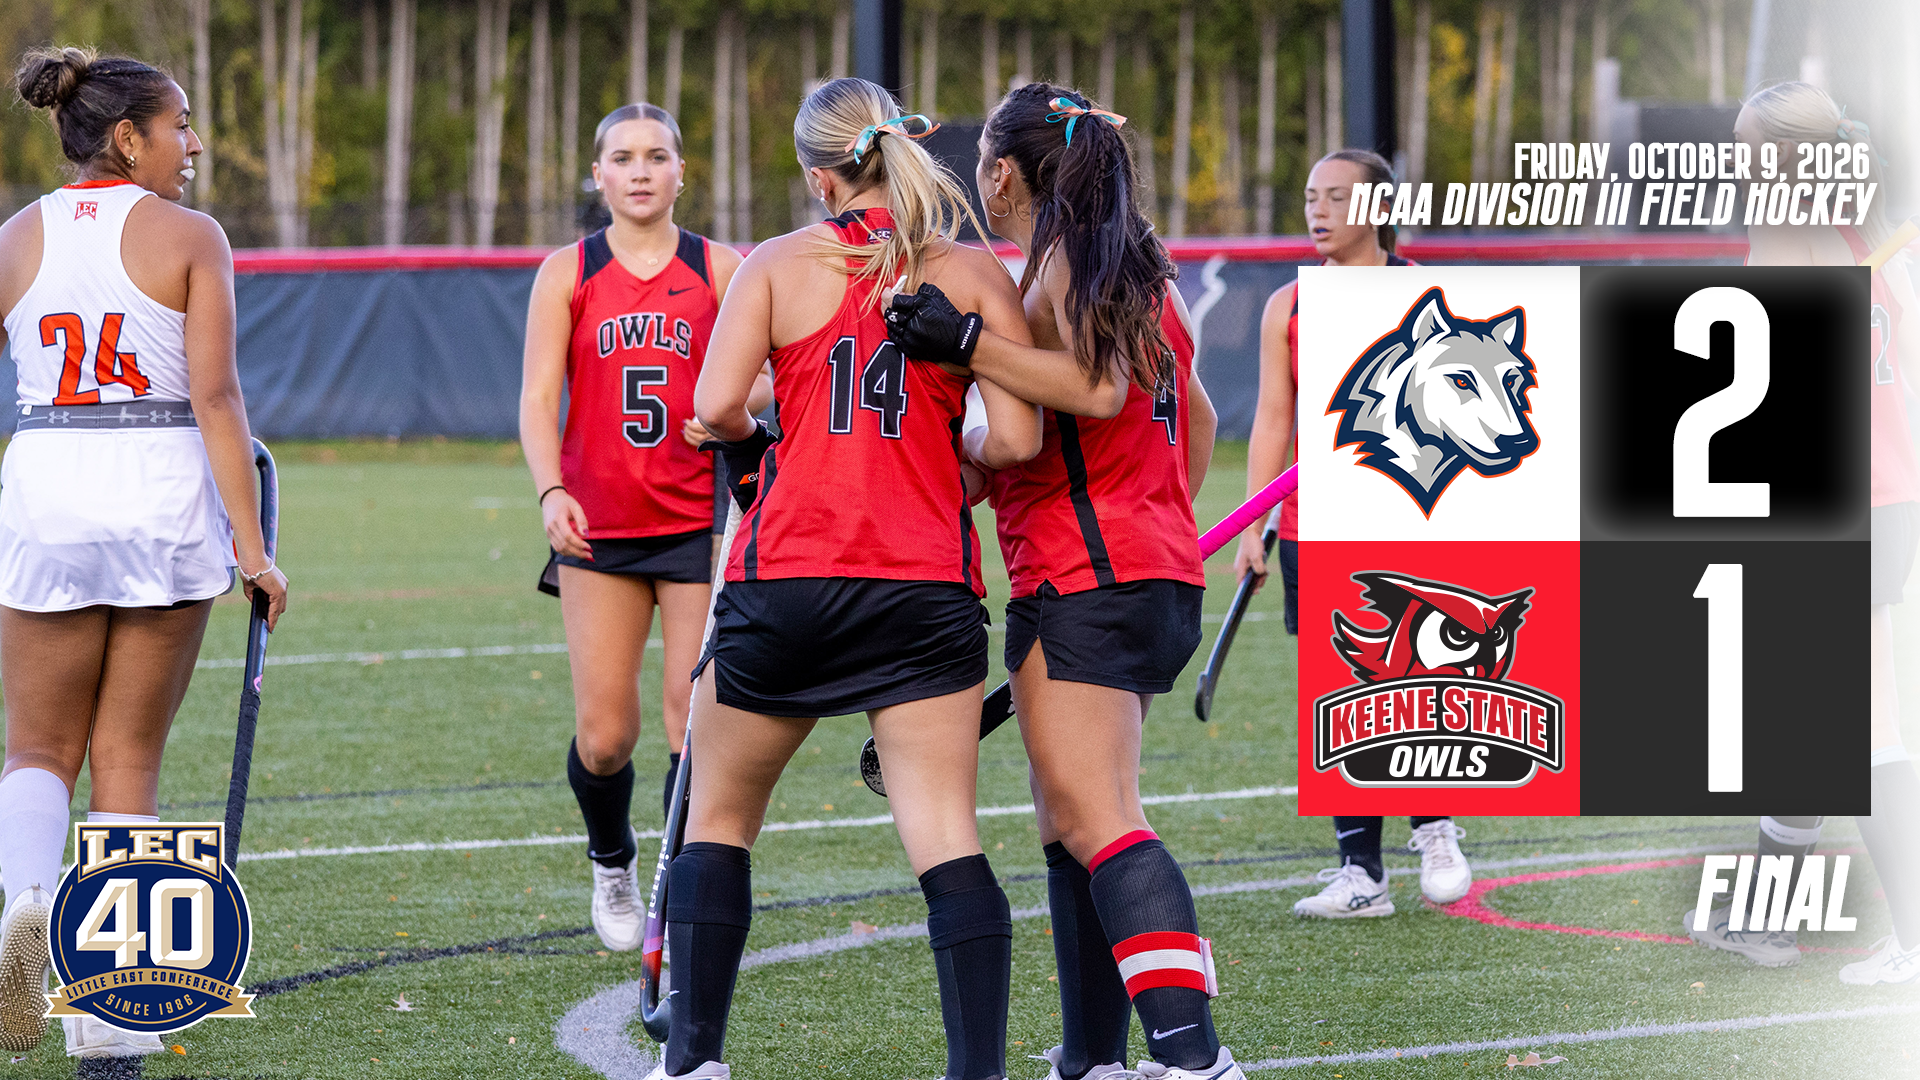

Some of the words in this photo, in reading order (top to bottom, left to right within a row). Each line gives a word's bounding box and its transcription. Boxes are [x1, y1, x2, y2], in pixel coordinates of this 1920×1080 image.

[76, 202, 97, 218] LEC
[38, 311, 154, 406] 24
[597, 312, 693, 359] OWLS
[960, 317, 976, 350] GRYPHON
[622, 365, 669, 448] 5
[827, 335, 909, 441] 14
[647, 837, 670, 919] ritual
